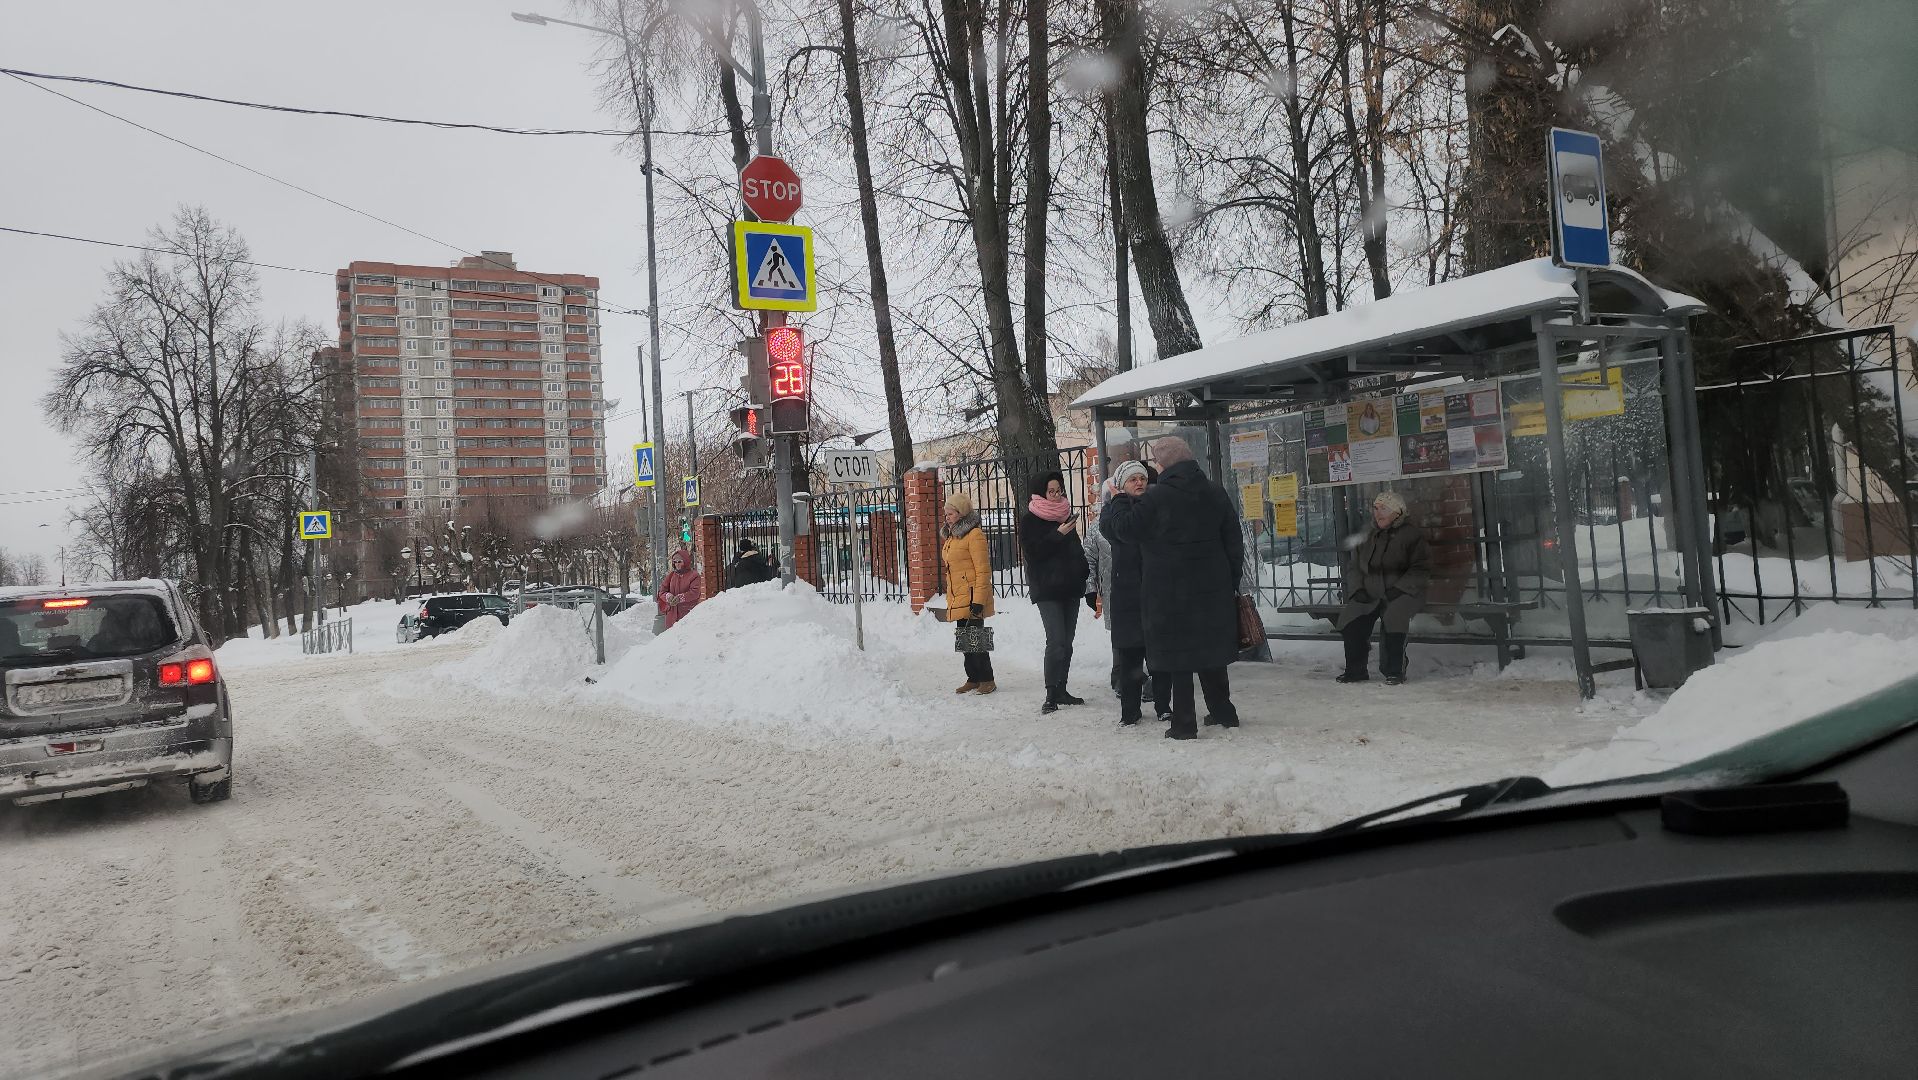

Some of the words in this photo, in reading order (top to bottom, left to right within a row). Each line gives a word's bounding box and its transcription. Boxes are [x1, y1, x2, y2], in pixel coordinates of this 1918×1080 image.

[746, 177, 799, 201] STOP
[775, 365, 804, 395] 28
[834, 455, 871, 477] СТОП
